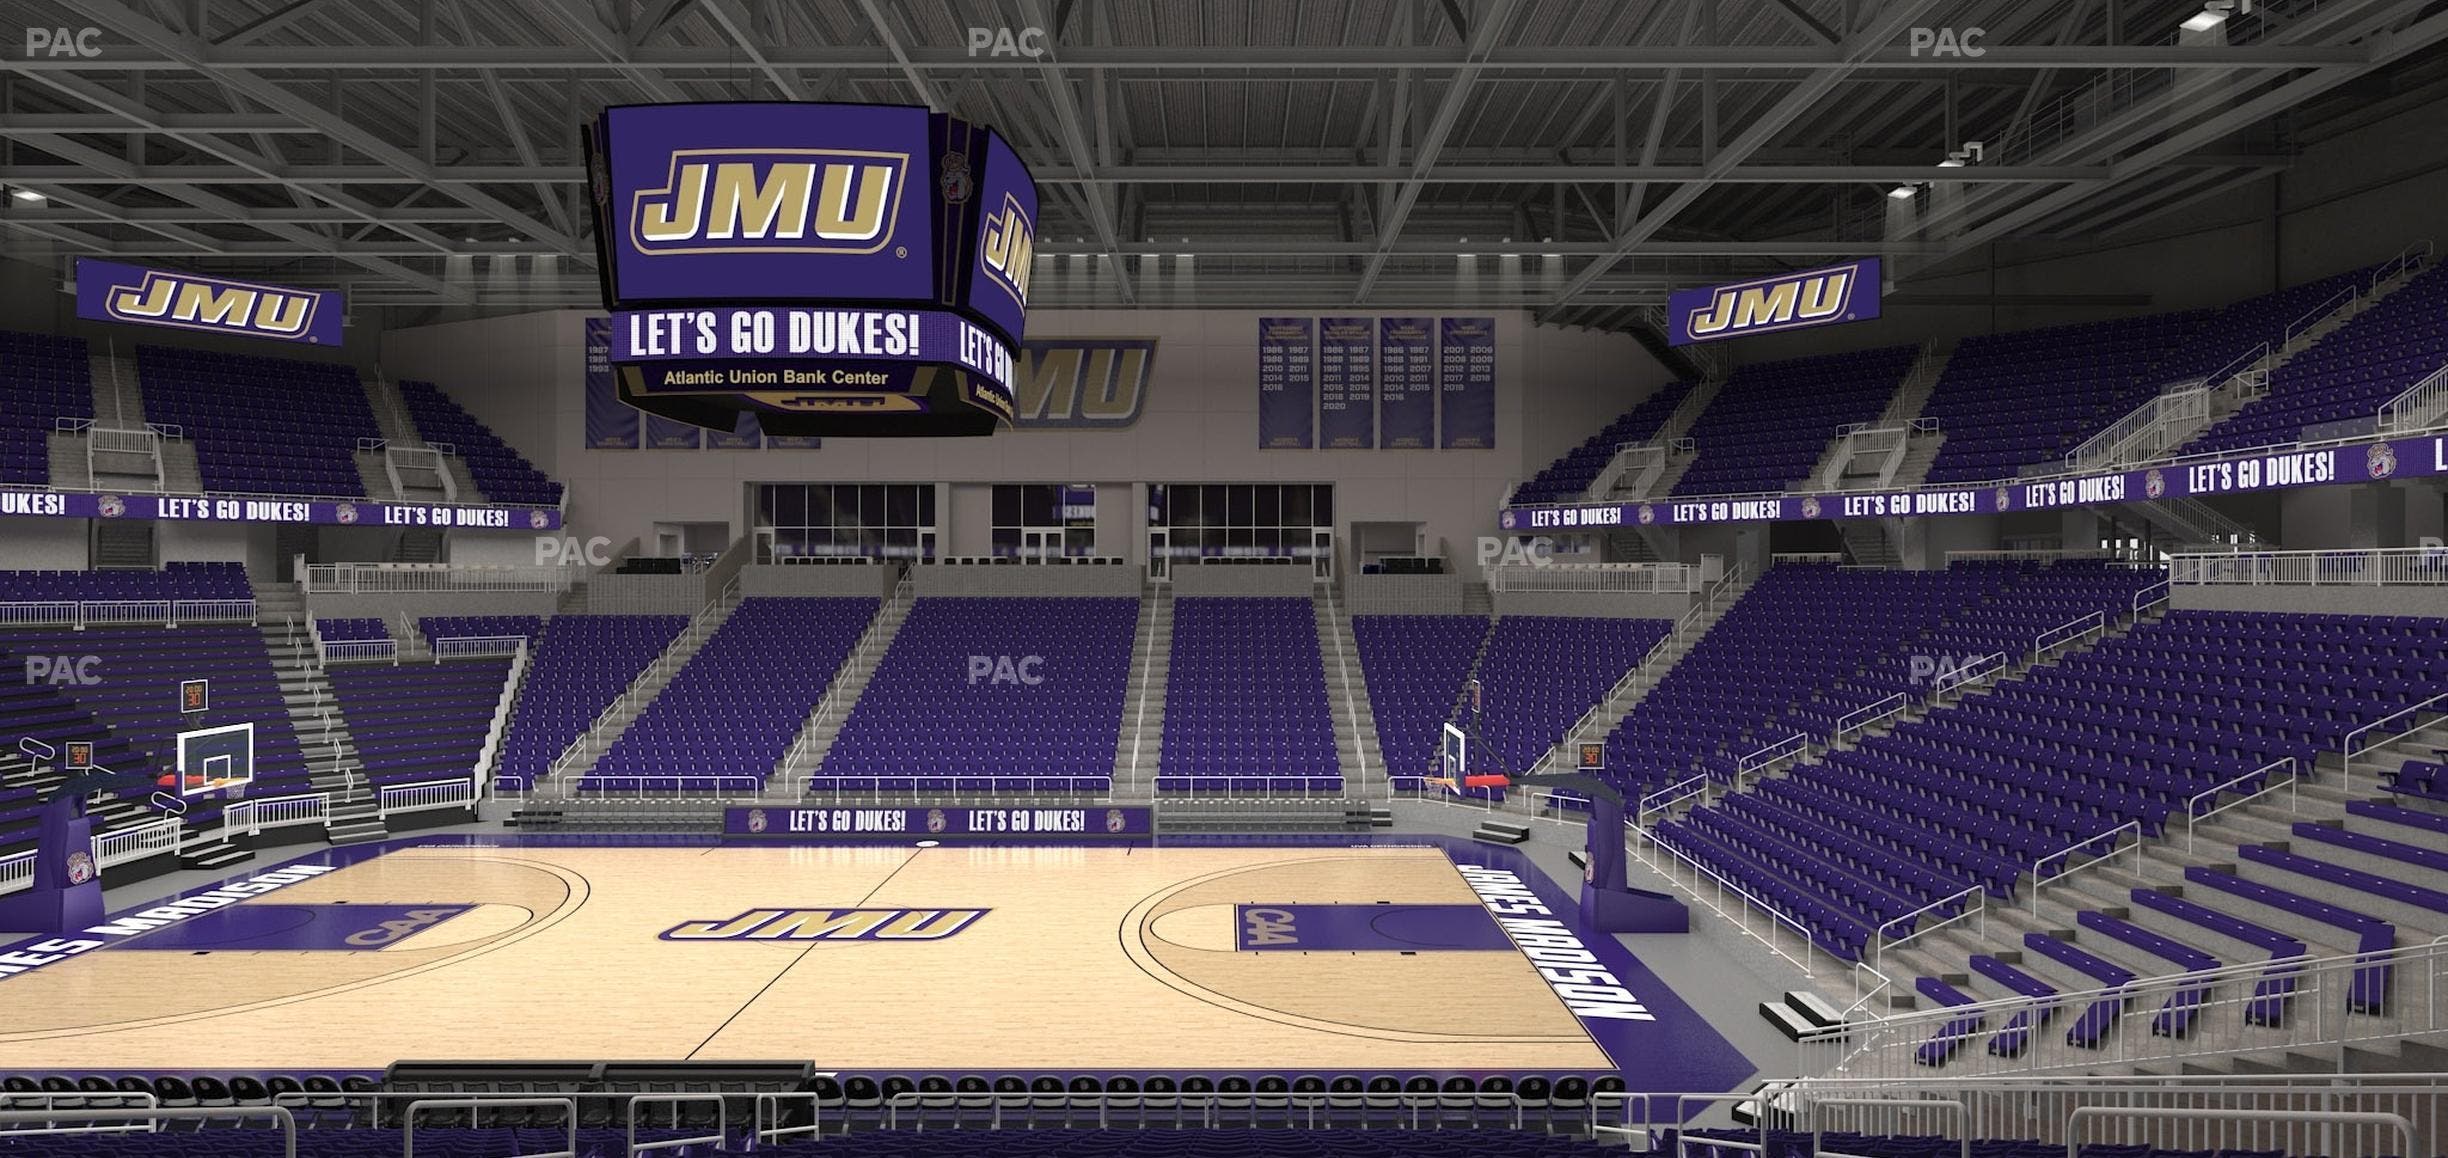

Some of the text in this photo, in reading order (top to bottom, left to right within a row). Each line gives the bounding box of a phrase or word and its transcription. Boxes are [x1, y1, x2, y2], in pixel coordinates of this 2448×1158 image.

[640, 161, 894, 242] JMU
[985, 206, 1033, 308] JM
[115, 277, 311, 333] JMU
[1693, 272, 1849, 334] JMU
[630, 310, 919, 357] LET'S GO DUKES!
[960, 320, 993, 375] LET'S
[1443, 346, 1465, 354] 2001
[664, 370, 889, 385] Atlantic Union Bank Center
[1262, 364, 1308, 372] 2010 2011
[1262, 374, 1283, 382] 2014
[1323, 374, 1370, 382] 2011 2014
[1409, 364, 1432, 372] 2007
[1409, 374, 1428, 382] 2011
[1013, 348, 1148, 419] MU
[1323, 402, 1346, 410] 2020
[2189, 450, 2335, 493] LET'S GO DUKES!
[0, 493, 65, 515] UKES!
[1844, 491, 1975, 516] LET'S GO DUKES!
[2026, 475, 2125, 508] LET'S GO DUKES!
[158, 497, 310, 522] LET'S GO DUKES!
[383, 505, 509, 527] LET'S GO DUKES!
[1531, 507, 1621, 527] LET'S GO DUKES!
[1673, 499, 1781, 522] LET'S GO DUKES!
[187, 693, 201, 706] 30
[789, 810, 906, 832] LET'S GO DUKES!
[969, 810, 1085, 832] LET'S GO DUKES!
[82, 863, 338, 936] MADISON
[344, 908, 463, 946] CAA
[666, 909, 984, 939] JMU
[1244, 908, 1299, 946] CAA
[1456, 863, 1657, 1022] JAMES MADISON
